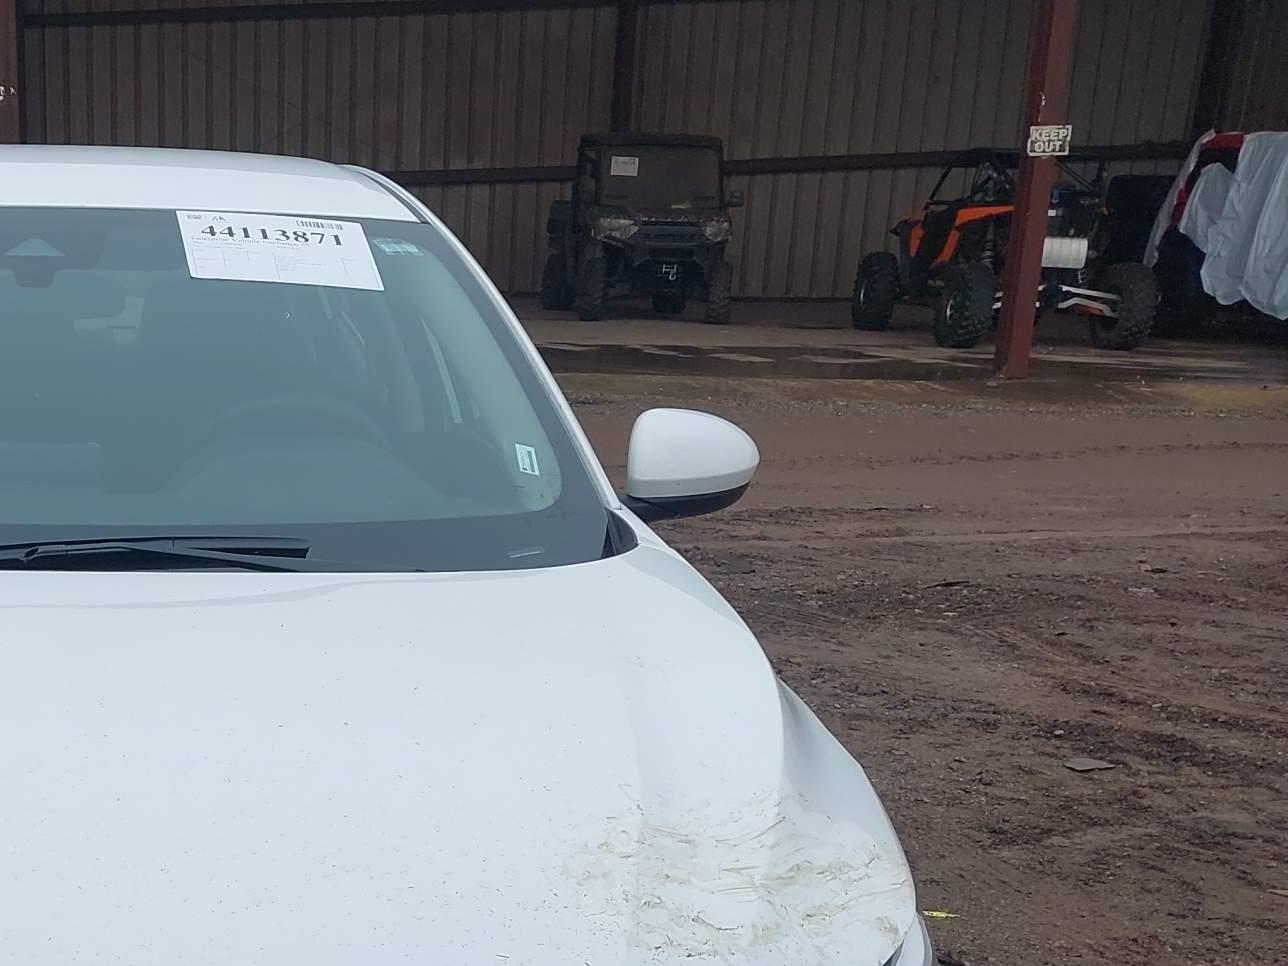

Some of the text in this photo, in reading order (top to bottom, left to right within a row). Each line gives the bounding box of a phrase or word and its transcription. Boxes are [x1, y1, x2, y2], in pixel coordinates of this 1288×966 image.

[1032, 129, 1068, 140] KEEP
[1034, 141, 1063, 152] OUT
[201, 225, 344, 246] 44113871
